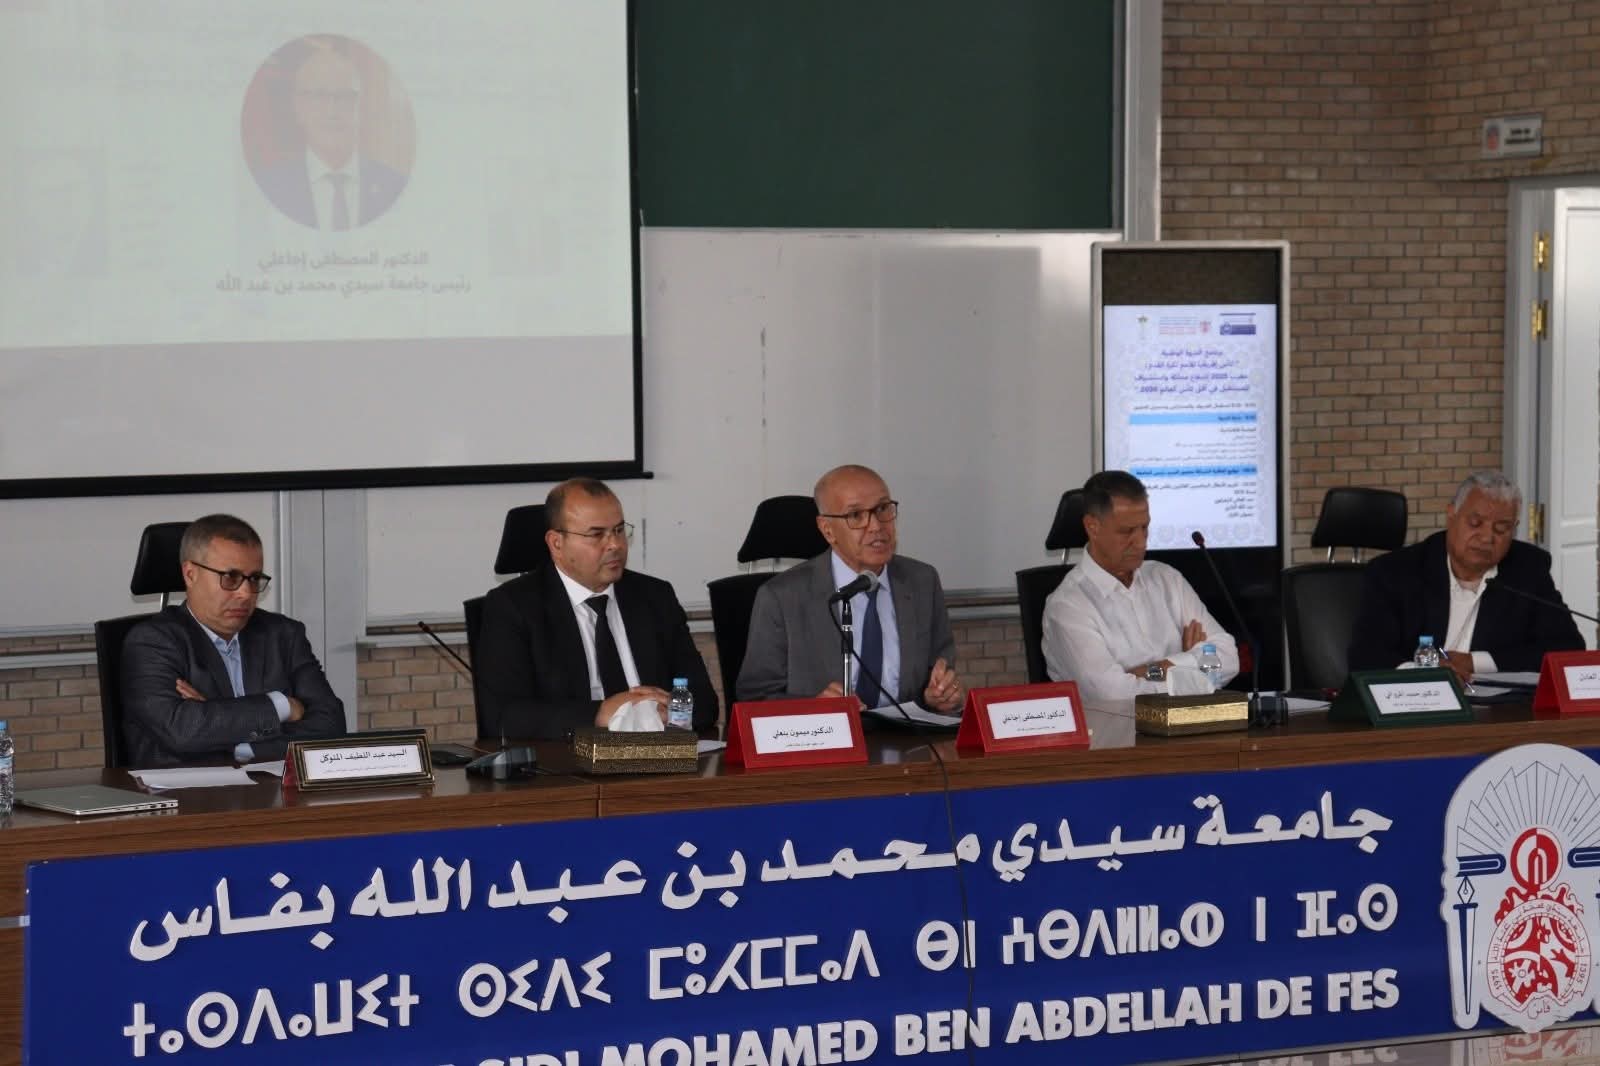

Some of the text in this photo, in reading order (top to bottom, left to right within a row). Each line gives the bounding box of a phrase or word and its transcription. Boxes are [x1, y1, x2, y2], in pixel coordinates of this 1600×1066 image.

[383, 250, 430, 269] الدكتور
[215, 270, 472, 299] رئيس جامعة سيدي محمد بن عبد الله
[790, 729, 810, 737] ميمون
[810, 726, 834, 737] الدكتور
[320, 748, 407, 764] السيد عبد اللطيف المتوكل
[129, 790, 1393, 962] جامعة سيدي محمد بن عبد الله بفاس
[458, 951, 612, 1018] ⵙⵉⴷⵉ
[600, 968, 1400, 1066] MOHAMED BEN ABDELLAH DE FES
